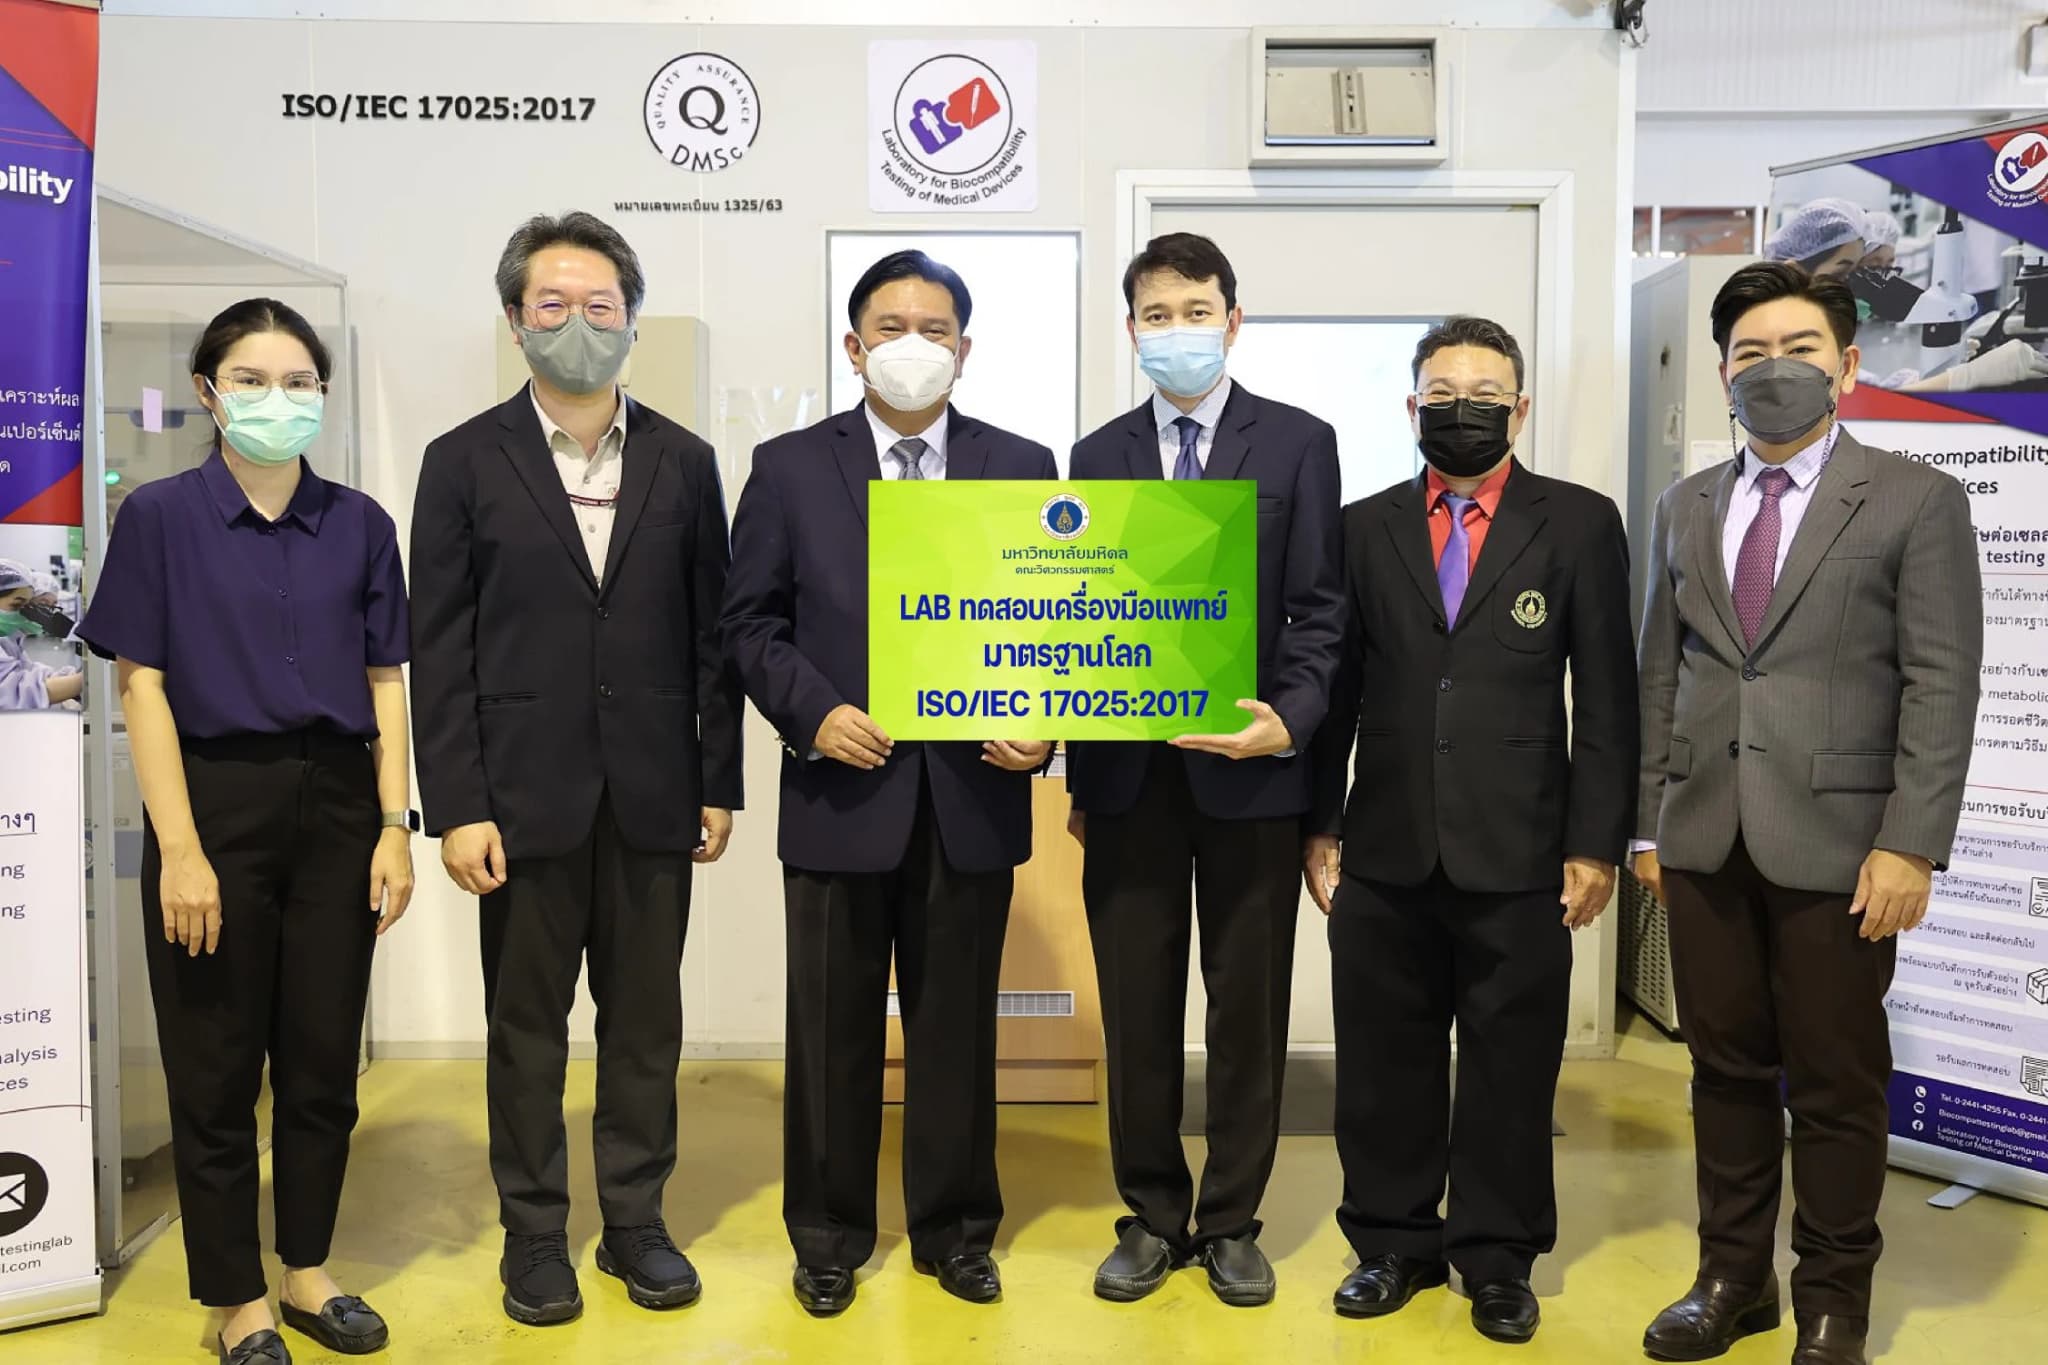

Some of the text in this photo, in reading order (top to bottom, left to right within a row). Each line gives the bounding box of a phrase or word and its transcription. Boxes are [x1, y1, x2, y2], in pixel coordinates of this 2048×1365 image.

[282, 93, 596, 123] ISO/IEC 17025:2017
[654, 64, 750, 130] QUALITY ASSURANCE
[678, 85, 729, 136] Q
[671, 143, 743, 172] DMSc
[881, 126, 1028, 190] Laboratory for Biocompatibility
[880, 161, 1023, 205] Testing of Medical Devices
[724, 198, 783, 213] 1325/63
[1002, 545, 1128, 560] มหาวิทยาลัยมหิดล
[1986, 549, 2046, 567] testing
[1015, 564, 1116, 575] คณะวิศวกรรมศาสตร์
[899, 581, 1228, 621] LAB ทดสอบเครื่องมือแพทย์
[983, 634, 1152, 675] มาตรฐานโลก
[917, 689, 1209, 718] ISO/IEC 17025:2017
[0, 1007, 52, 1024] sting
[0, 1045, 58, 1066] alysis
